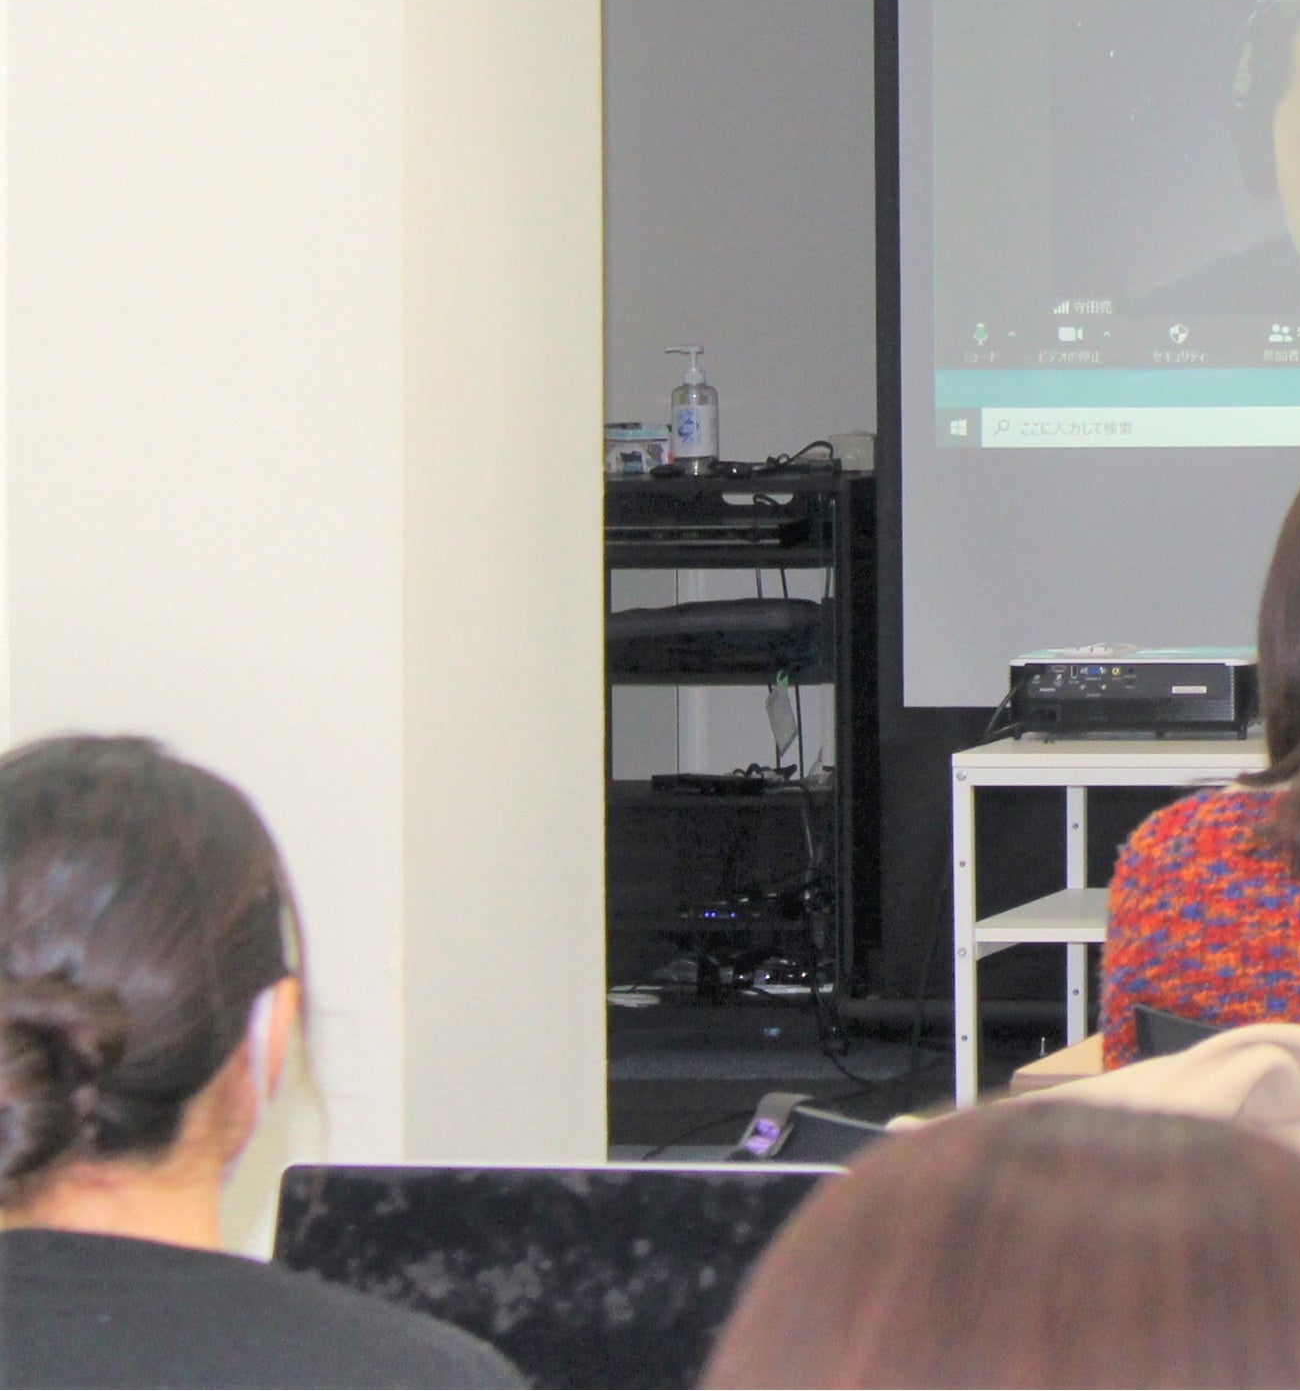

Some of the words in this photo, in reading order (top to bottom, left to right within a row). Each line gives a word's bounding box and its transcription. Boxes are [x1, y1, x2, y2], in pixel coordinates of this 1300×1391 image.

[1038, 351, 1103, 364] ビデオの停止
[1153, 350, 1206, 363] セキュリティ
[1020, 421, 1132, 436] ここに入力して検索
